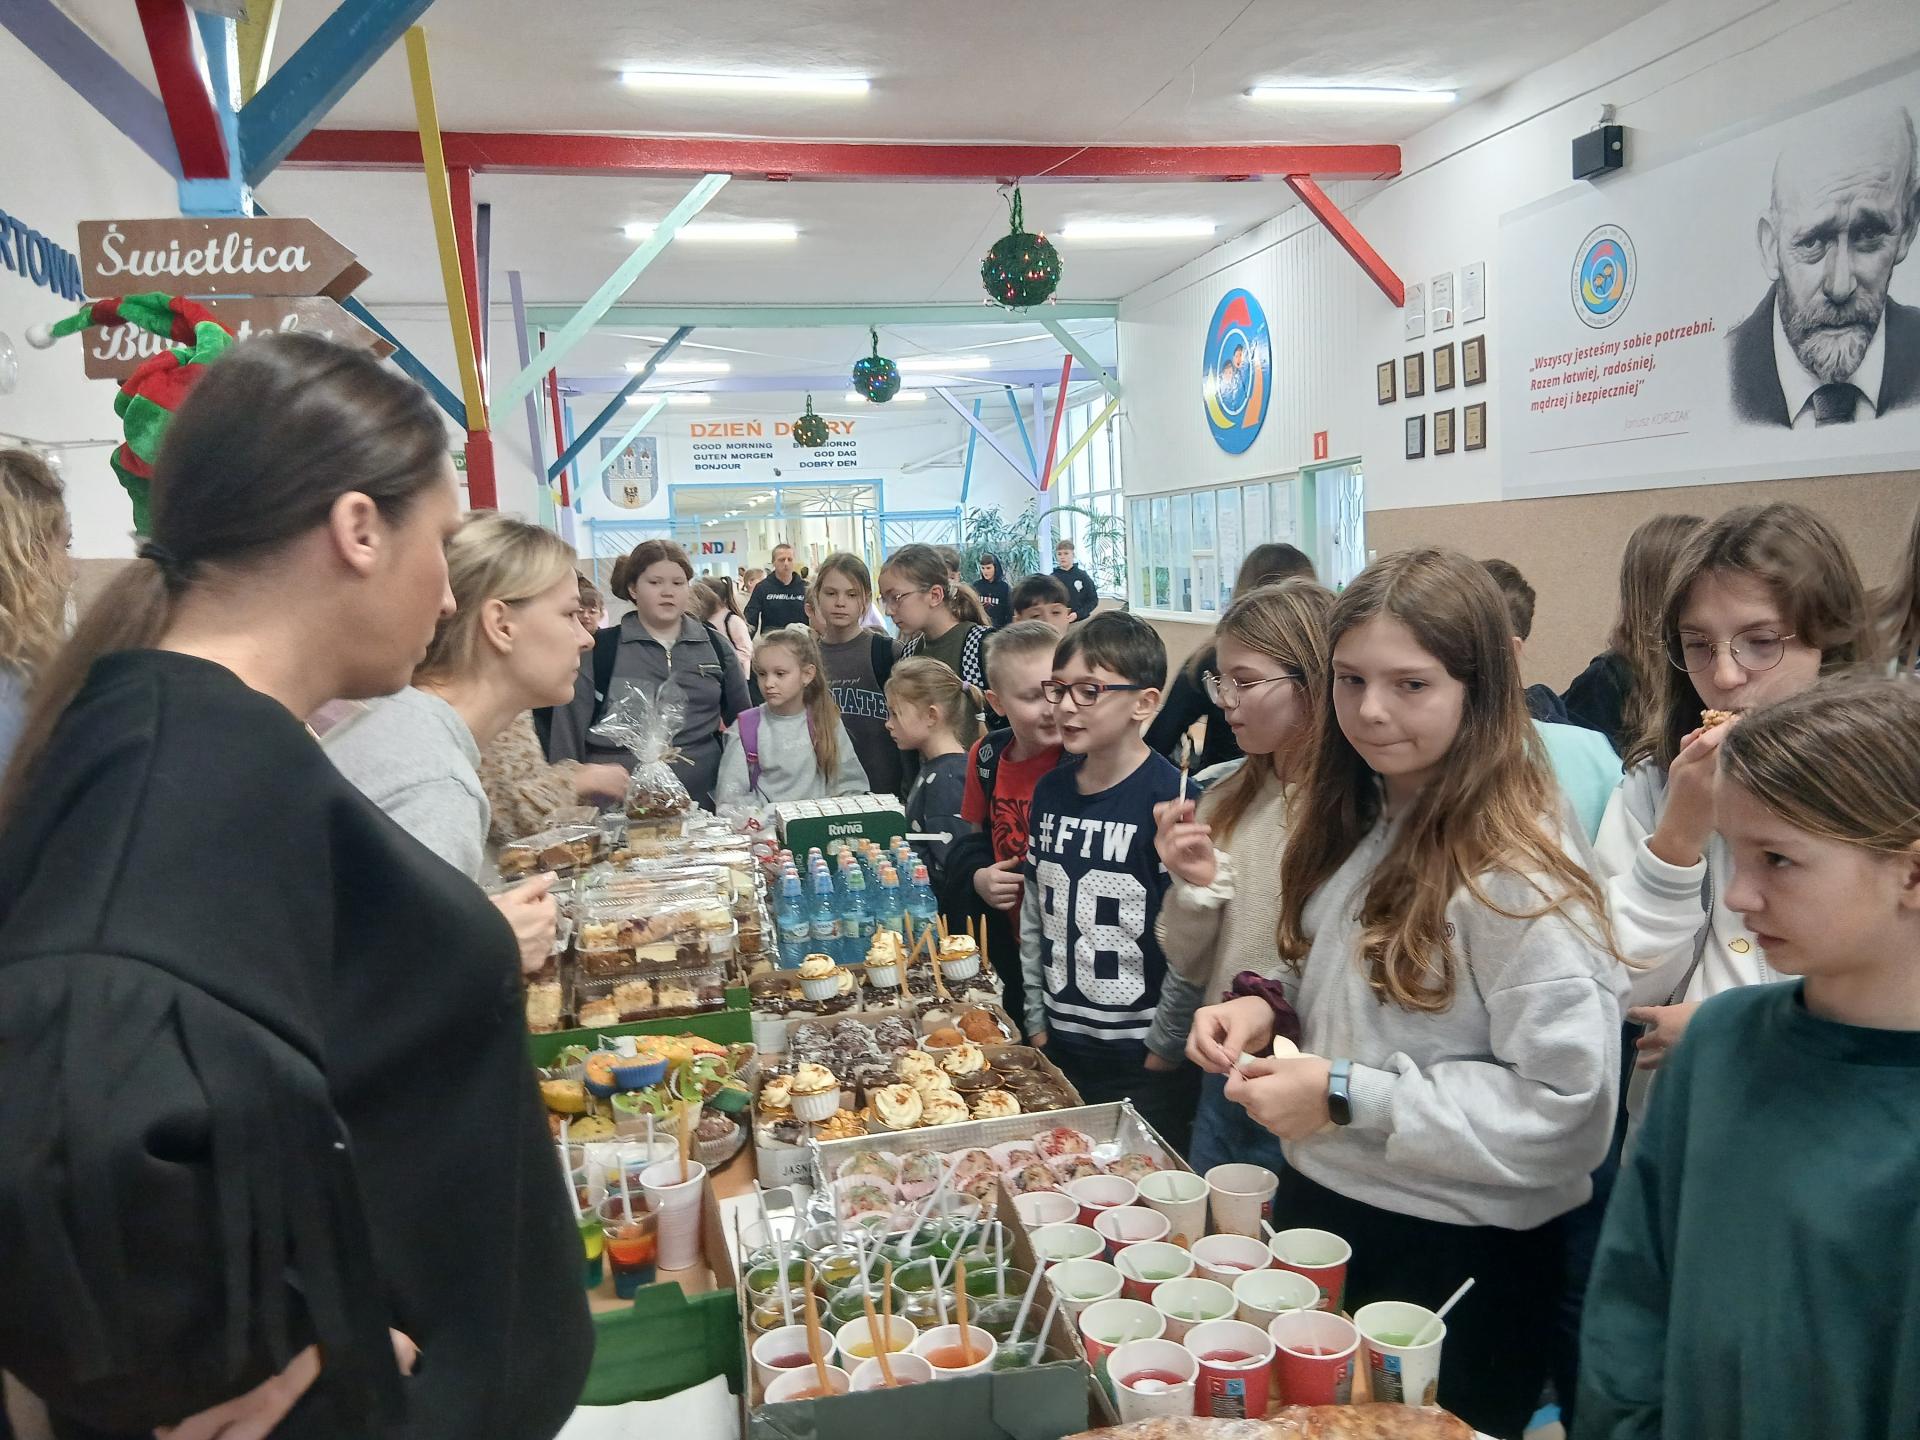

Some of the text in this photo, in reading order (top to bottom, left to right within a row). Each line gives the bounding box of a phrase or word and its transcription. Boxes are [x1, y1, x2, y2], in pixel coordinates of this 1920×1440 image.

[97, 224, 310, 277] Świetlica
[1574, 340, 1621, 364] jesteśmy
[1623, 331, 1652, 351] sobie
[1655, 317, 1716, 347] potrzebni.
[1530, 354, 1656, 391] Razem łatwiej, radośniej,
[1530, 395, 1567, 413] mądrzej
[690, 419, 762, 438] DZIEŃ
[694, 452, 773, 461] GUTEN MORGEN
[726, 442, 773, 450] MORNING
[695, 462, 741, 470] BONJOUR
[1039, 812, 1138, 863] #FTW
[1036, 859, 1147, 1006] 98
